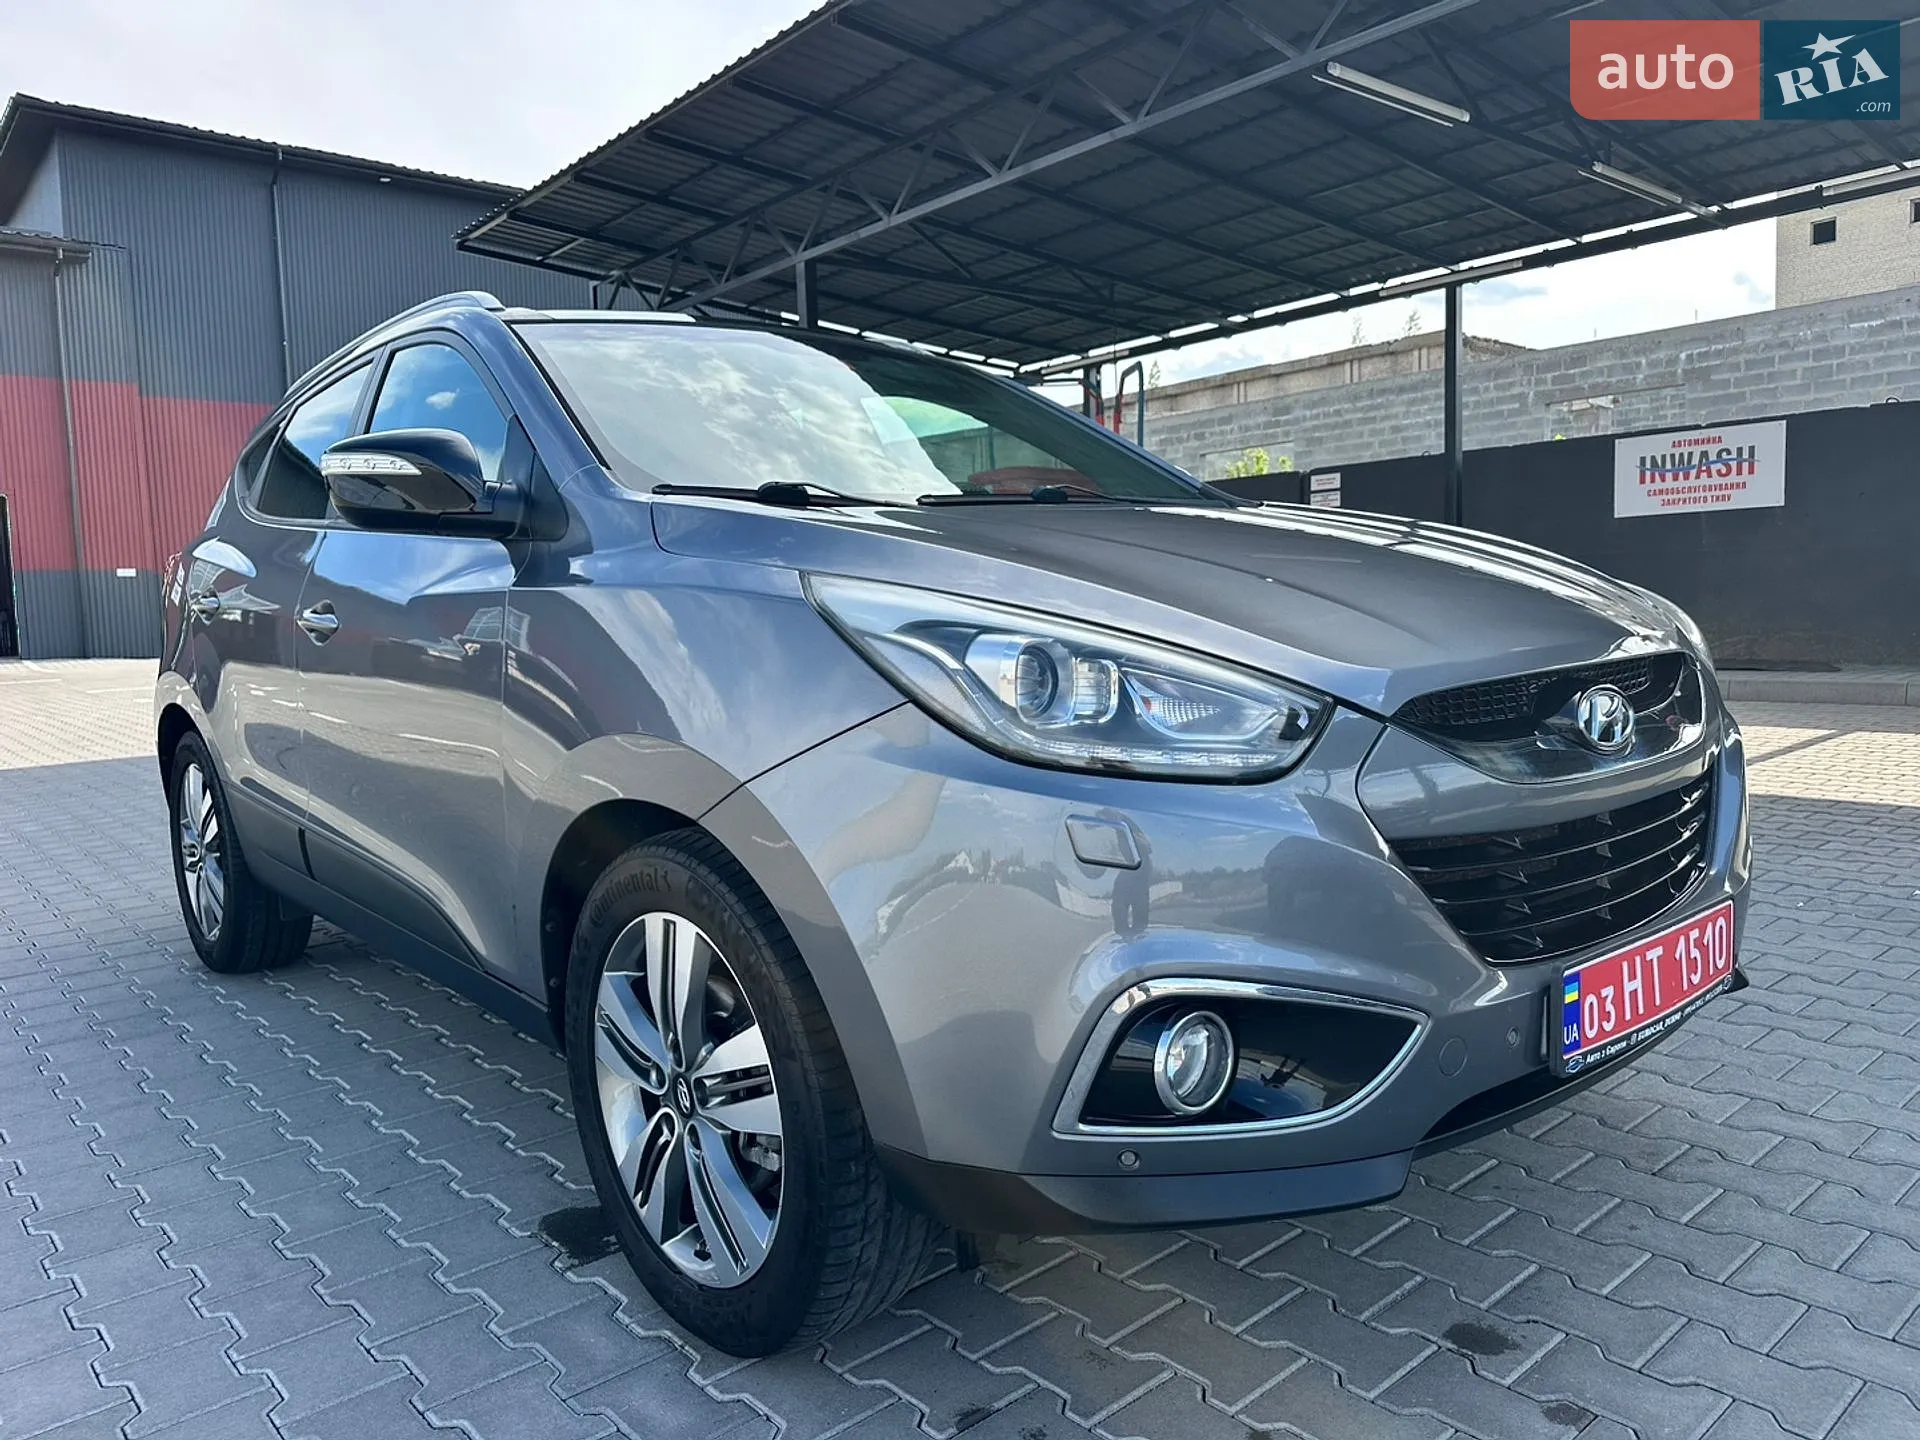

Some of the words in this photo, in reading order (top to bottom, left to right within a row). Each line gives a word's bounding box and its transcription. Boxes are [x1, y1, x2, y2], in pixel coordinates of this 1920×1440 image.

[1671, 435, 1723, 448] АВТОМИЙКА
[1639, 445, 1756, 485] INWASH
[1660, 495, 1708, 507] ЗАКРИТОГО
[1710, 493, 1732, 504] ТИПУ
[1584, 985, 1616, 1039] 03
[1621, 945, 1664, 1021] HT
[1674, 916, 1727, 992] 1510
[1564, 1023, 1579, 1045] UA
